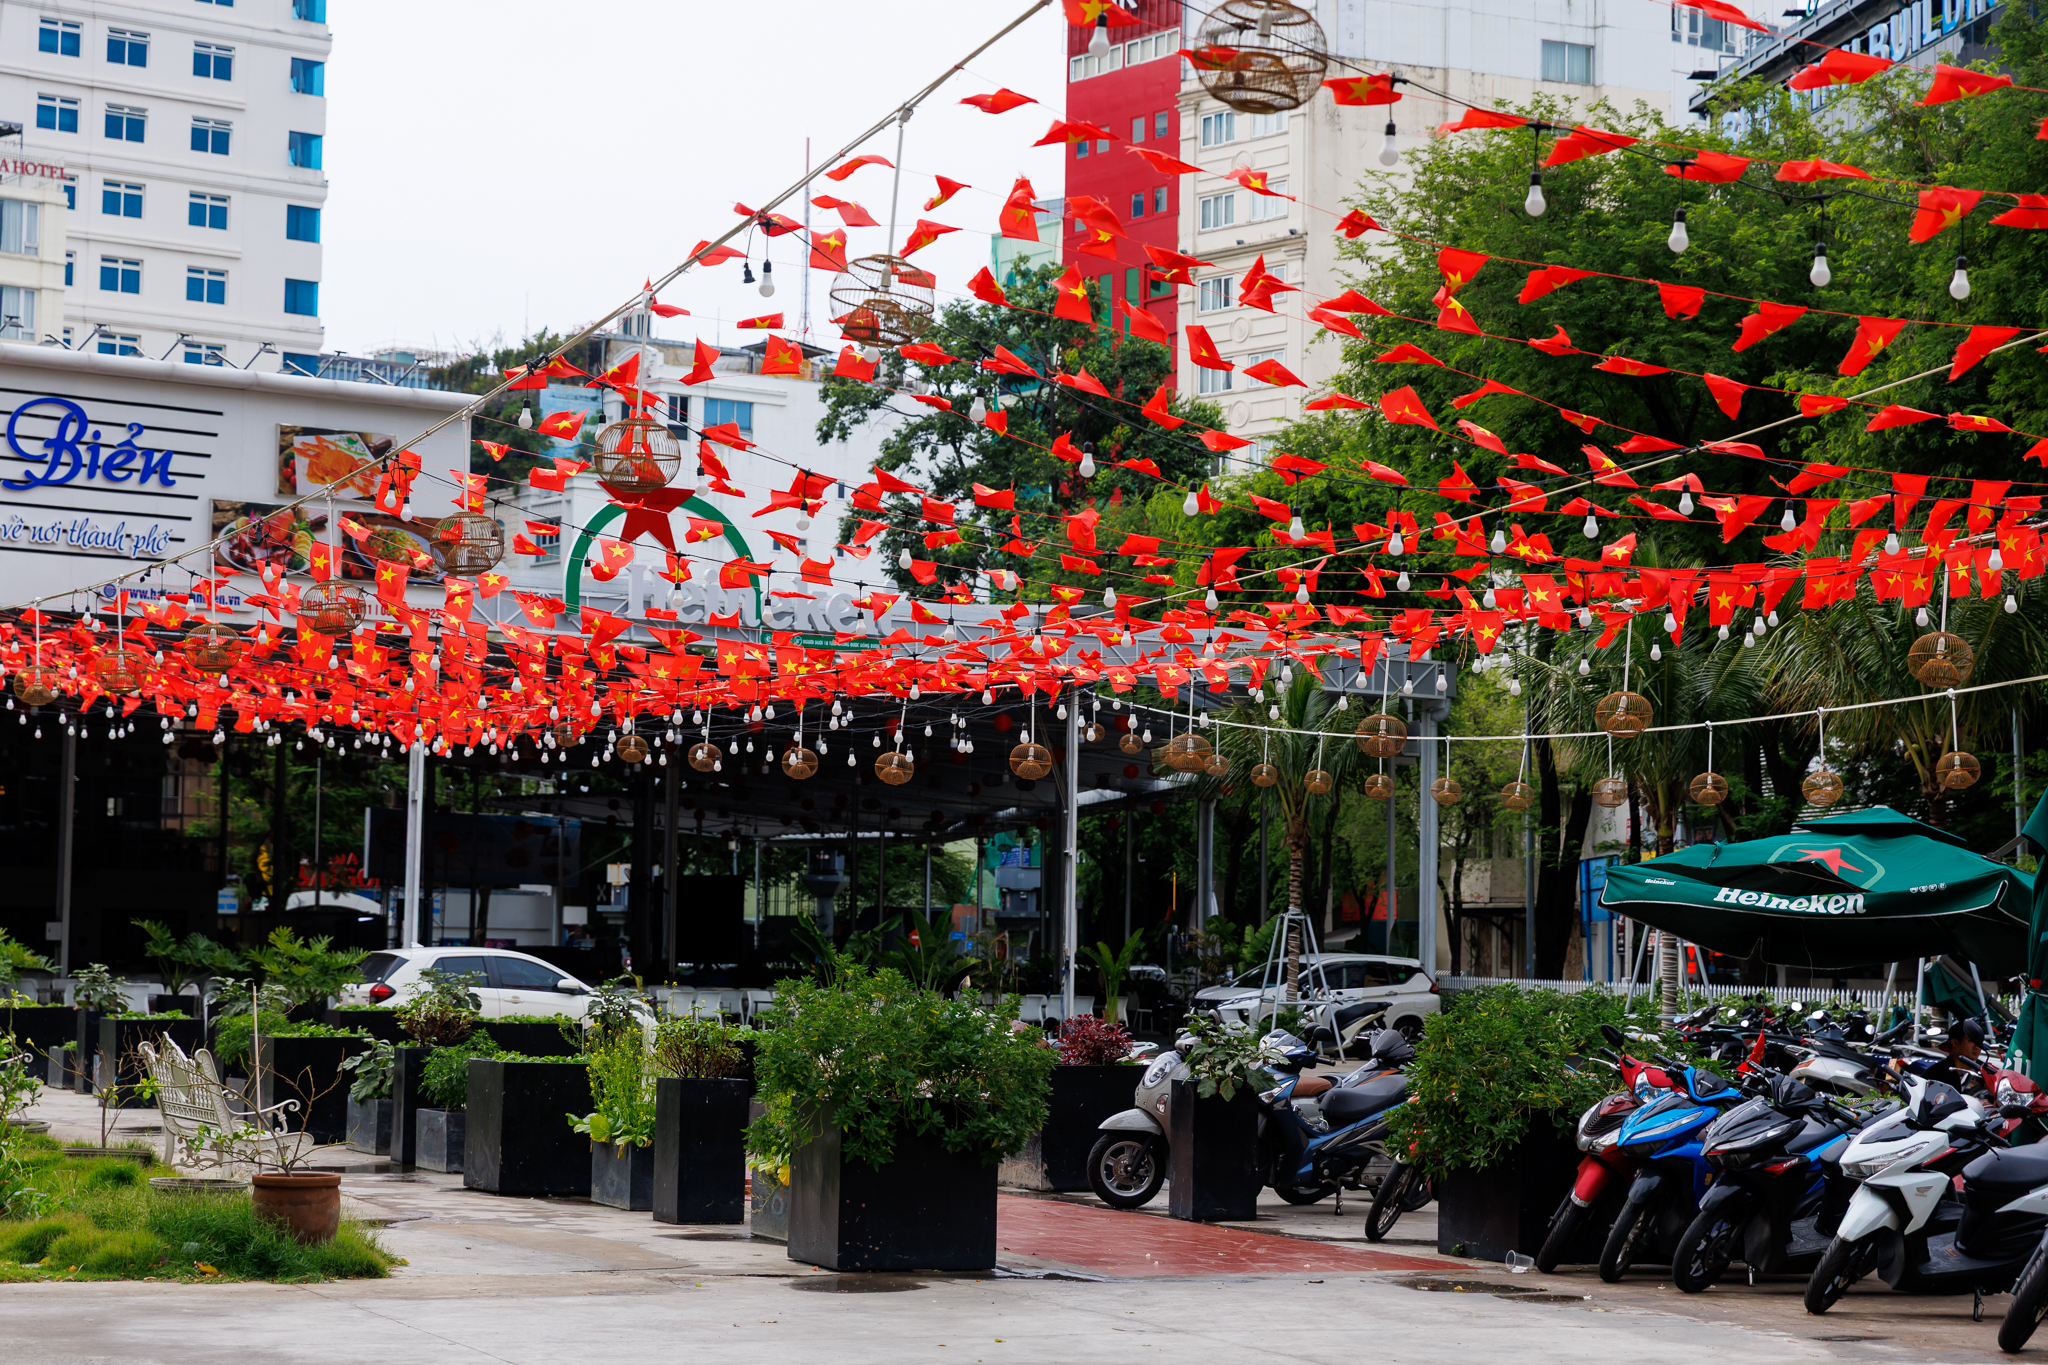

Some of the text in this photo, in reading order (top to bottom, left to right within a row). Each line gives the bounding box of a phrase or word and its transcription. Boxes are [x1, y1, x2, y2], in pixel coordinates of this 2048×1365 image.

[13, 160, 70, 180] HOTEL
[2, 397, 176, 490] Biển
[1, 514, 174, 557] về nơi thành phố
[1713, 887, 1867, 914] Heineken
